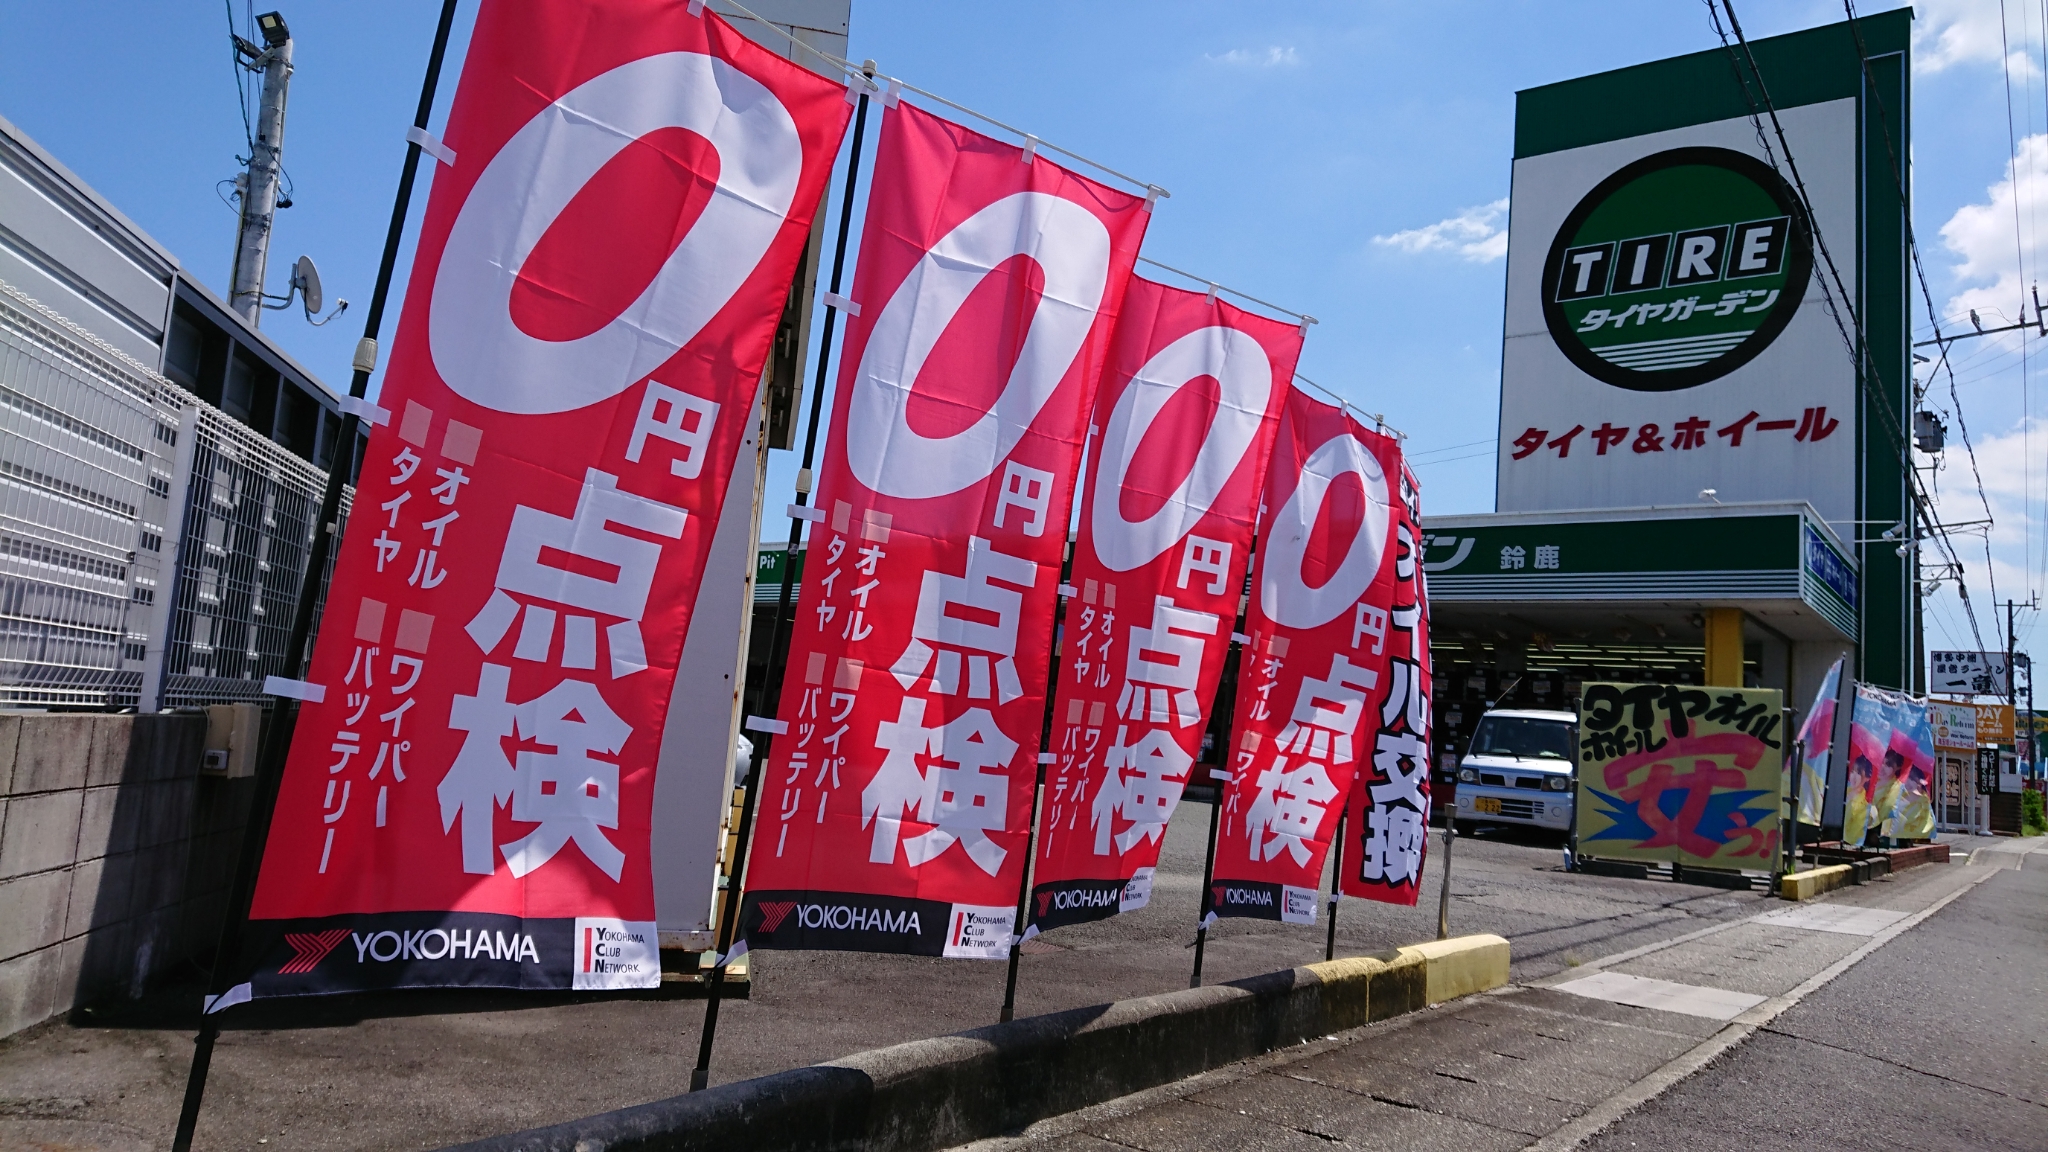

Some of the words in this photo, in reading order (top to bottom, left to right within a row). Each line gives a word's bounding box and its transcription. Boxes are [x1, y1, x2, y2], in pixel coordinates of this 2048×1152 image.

[1572, 226, 1774, 292] TIRE
[1577, 289, 1780, 333] タイヤガーデン
[1512, 407, 1839, 461] タイヤ&ホイール
[373, 446, 422, 573] タイヤ
[408, 467, 470, 590] オイル
[760, 554, 776, 569] Pit
[816, 534, 847, 633] タイヤ
[1500, 545, 1560, 570] 鈴鹿
[843, 544, 886, 642] オイル
[1073, 606, 1096, 683] タイヤ
[1094, 608, 1118, 689] オイル
[1249, 656, 1285, 722] オイル
[318, 646, 379, 874] バッテリー
[369, 654, 424, 828] ワイパー
[776, 688, 822, 858] バッテリー
[815, 692, 856, 824] ワイパー
[1046, 727, 1082, 858] バッテリー
[1069, 728, 1101, 831] ワイパー
[1227, 752, 1254, 836] ワイパー
[797, 904, 921, 936] YOKOHAMA
[966, 912, 1006, 926] YOKOHAMA
[1226, 888, 1273, 906] YOKOHAMA
[352, 929, 540, 964] YOKOHAMA
[595, 944, 622, 959] CLUB
[596, 927, 645, 944] YOKOHAMA
[961, 936, 998, 948] NETWORK
[964, 925, 986, 937] CLUB
[595, 957, 640, 975] NETWORK
